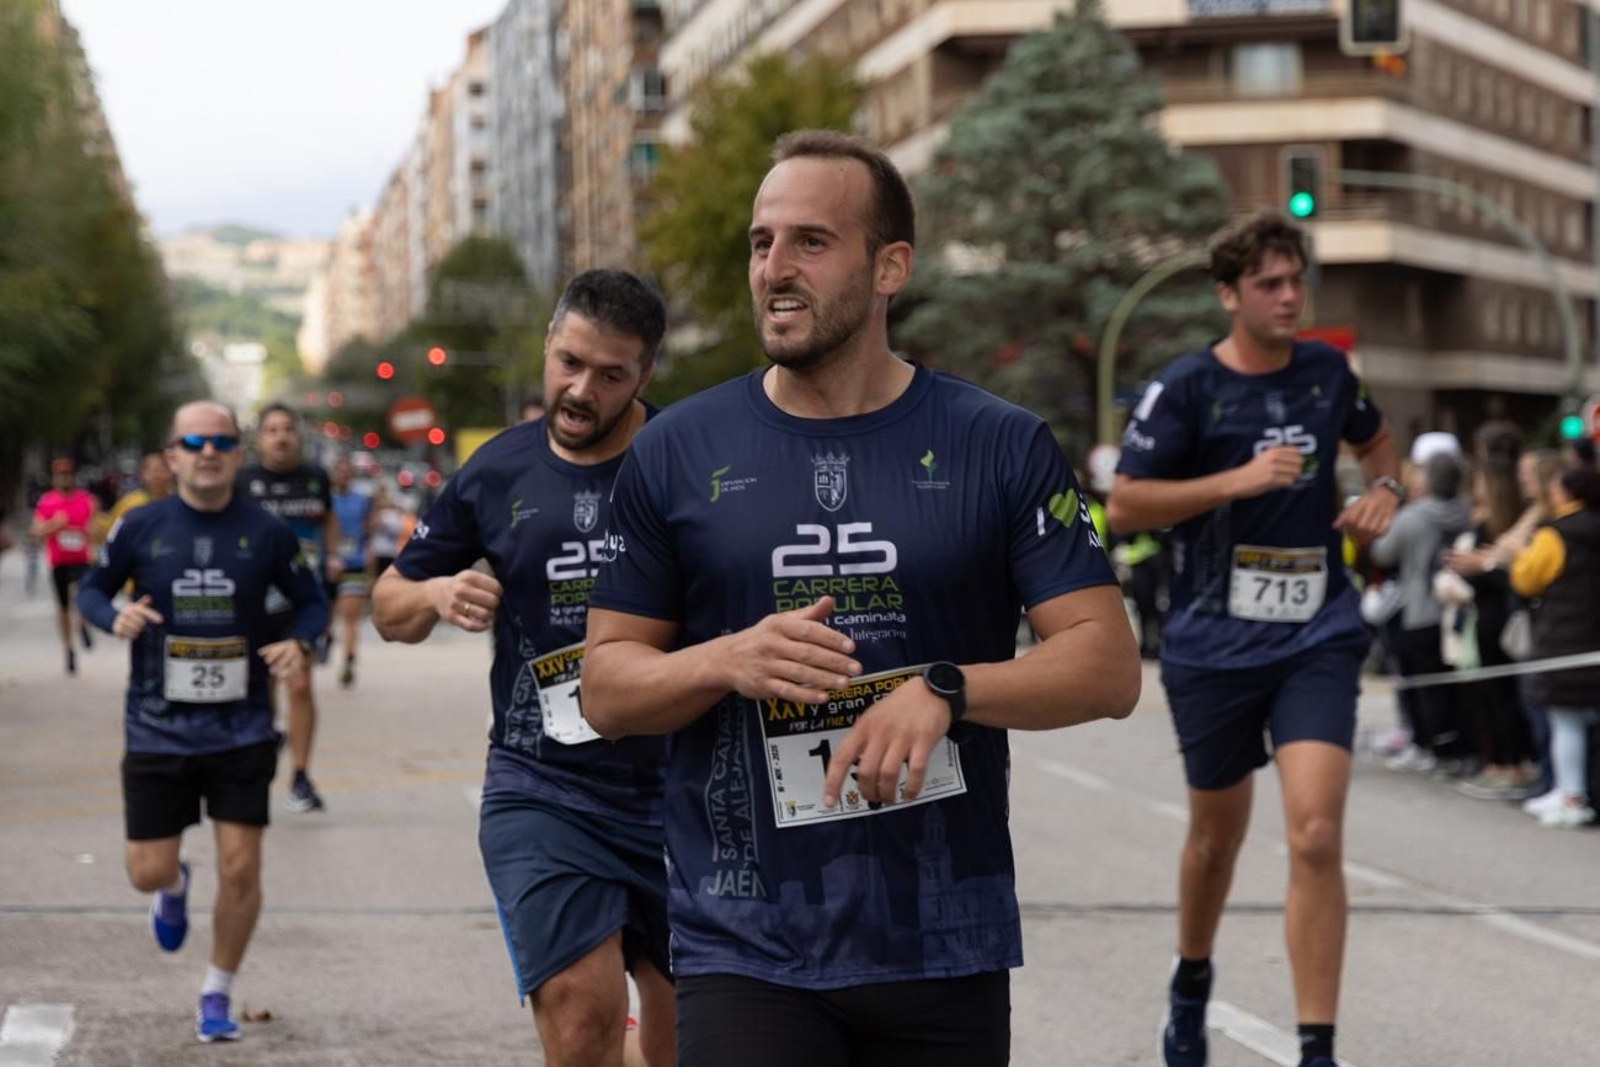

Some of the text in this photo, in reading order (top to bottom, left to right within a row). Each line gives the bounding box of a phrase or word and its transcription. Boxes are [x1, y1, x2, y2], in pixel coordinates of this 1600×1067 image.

[771, 522, 898, 577] 25
[171, 568, 237, 597] 25
[550, 579, 597, 592] CARR
[773, 576, 899, 597] CARRERA
[1253, 576, 1310, 607] 713
[834, 611, 907, 625] caminata
[191, 665, 226, 690] 25
[535, 655, 565, 679] XXV
[827, 684, 874, 701] RRERA
[827, 697, 866, 715] gran
[710, 787, 738, 861] SANTA
